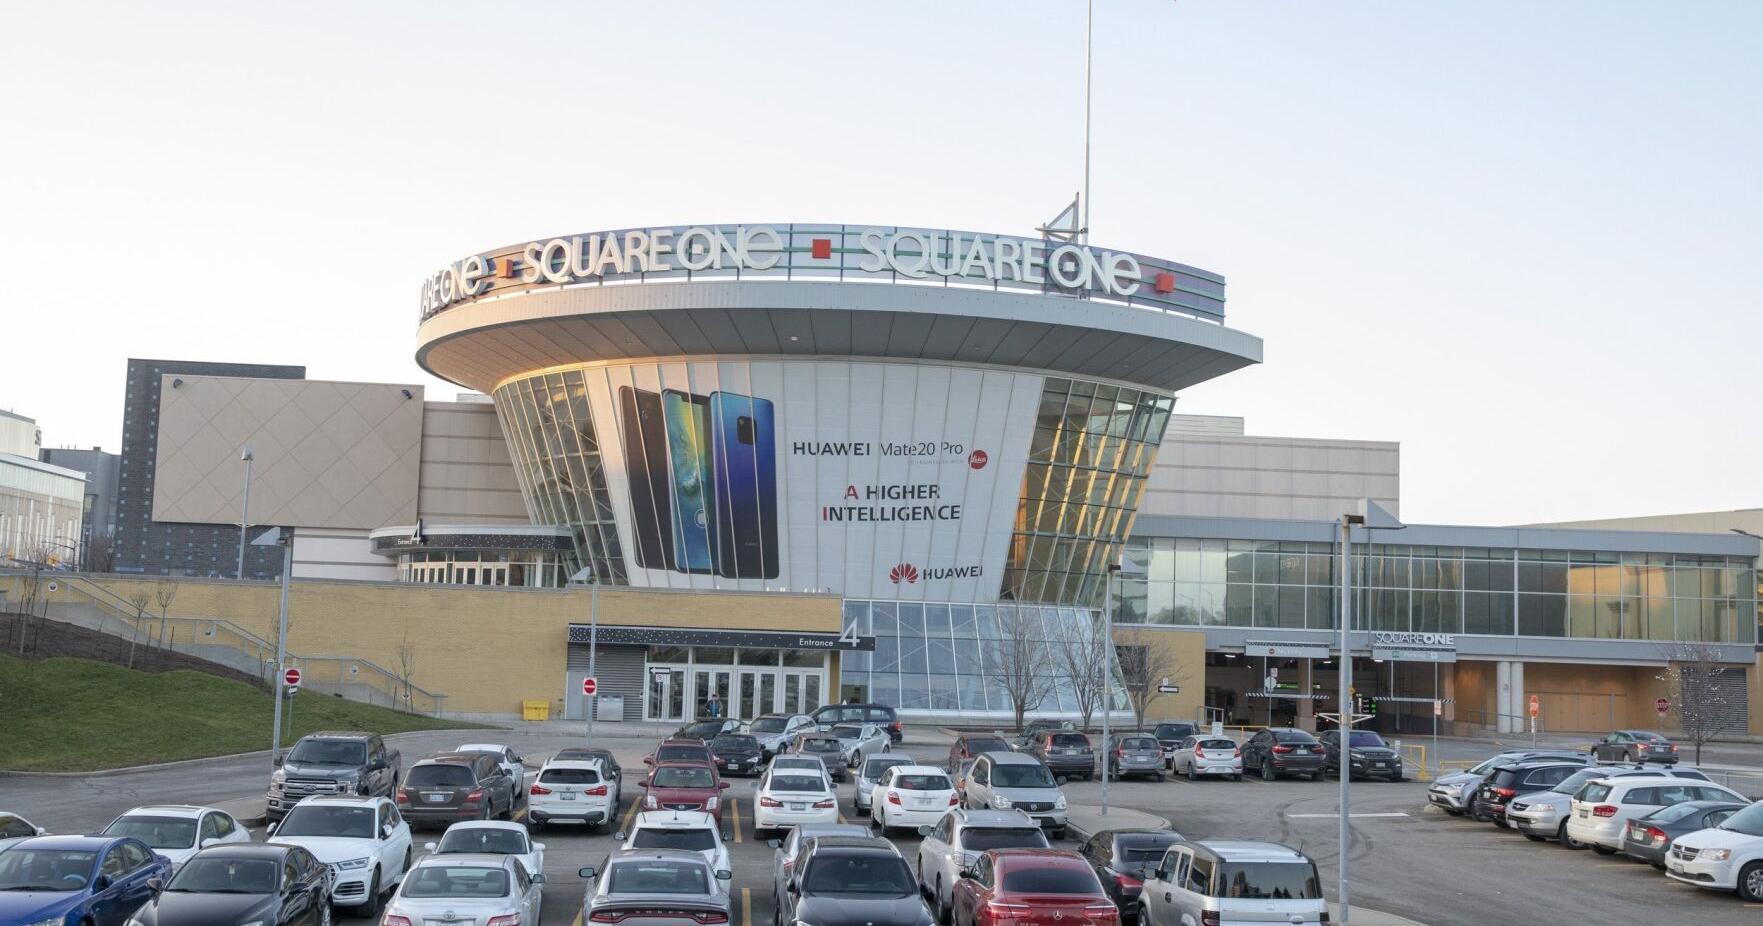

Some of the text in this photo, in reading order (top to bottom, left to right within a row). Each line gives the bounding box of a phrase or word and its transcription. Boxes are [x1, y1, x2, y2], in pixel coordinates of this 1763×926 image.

[524, 229, 673, 284] SQUARE
[859, 229, 1046, 279] SQUARE
[793, 441, 963, 456] HUAWEI Mate20 Pro
[844, 484, 940, 500] A HIGHER
[822, 505, 961, 522] INTELLIGENCE
[411, 519, 421, 545] 4
[922, 565, 983, 581] HUAWEI
[799, 615, 861, 648] Entrance 4
